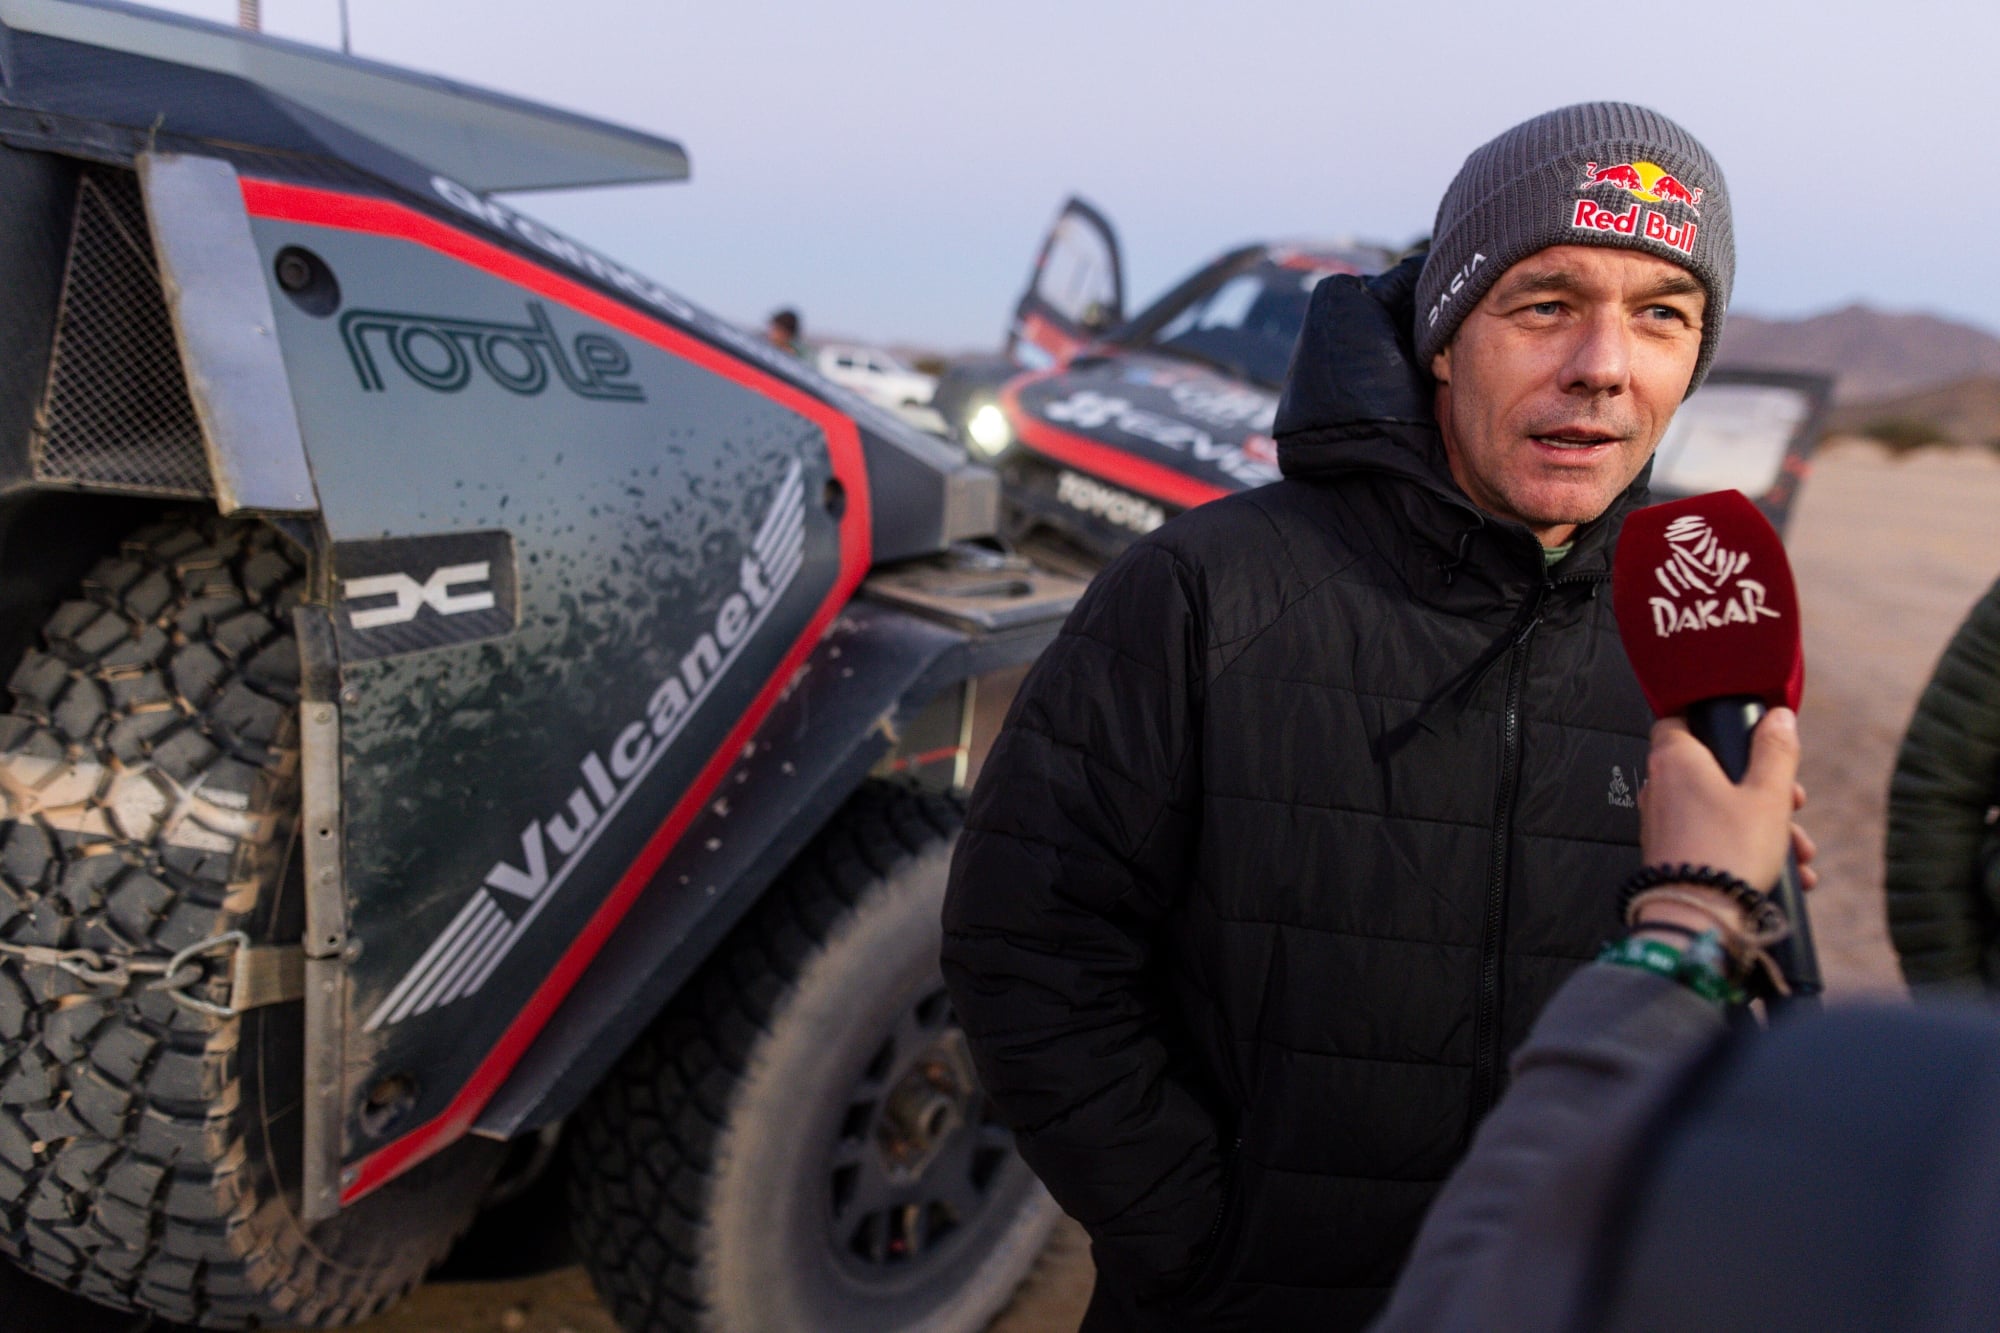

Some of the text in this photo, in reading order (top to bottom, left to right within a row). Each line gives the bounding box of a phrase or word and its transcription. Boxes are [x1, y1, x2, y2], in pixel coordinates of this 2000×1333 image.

[1572, 199, 1698, 256] Red Bull
[1428, 253, 1488, 328] DACIA
[339, 301, 648, 403] roole
[1057, 470, 1166, 535] TOYOTA
[1648, 579, 1781, 638] DAKAR
[484, 554, 772, 900] Vulcanet
